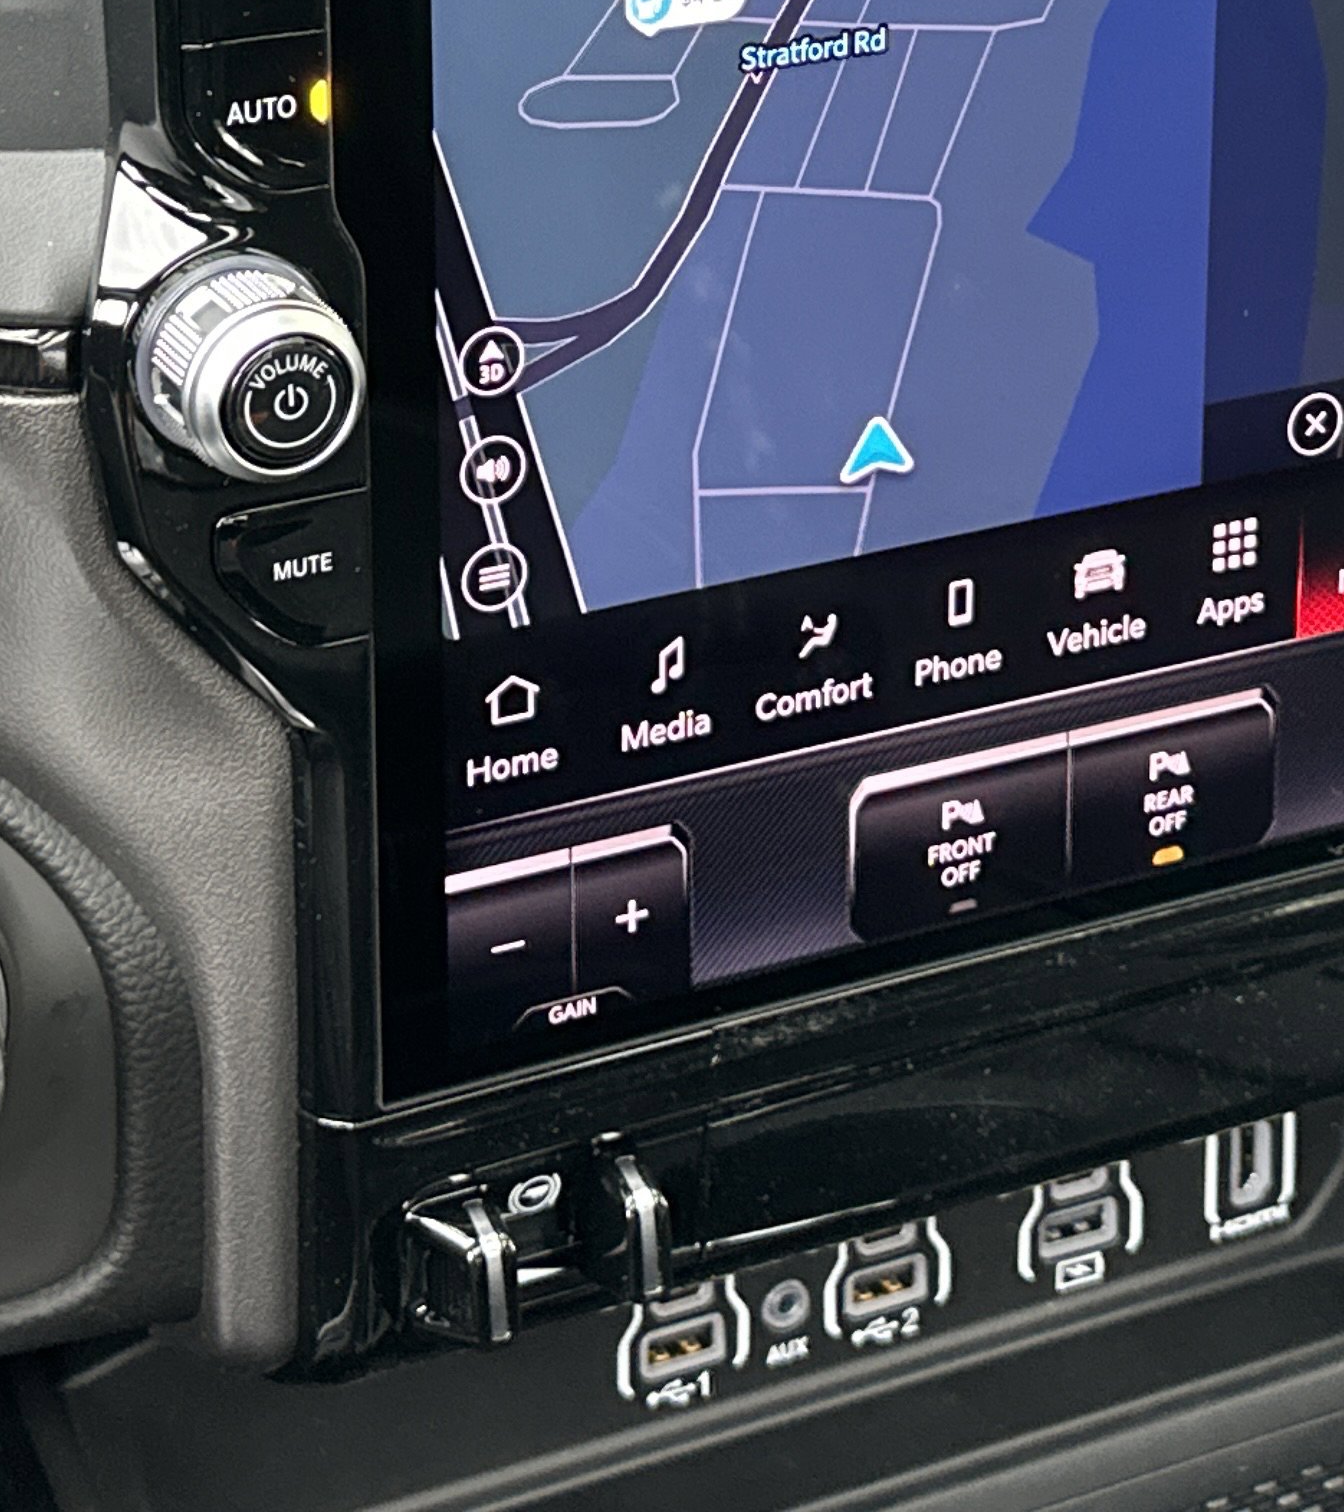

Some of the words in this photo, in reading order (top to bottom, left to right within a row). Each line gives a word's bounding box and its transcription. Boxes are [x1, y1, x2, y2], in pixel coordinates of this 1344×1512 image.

[741, 32, 848, 72] Stratford
[854, 27, 887, 52] Rd
[227, 95, 296, 126] AUTO
[248, 354, 330, 392] VOLUME
[478, 364, 505, 384] 3D
[273, 552, 333, 582] MUTE
[1197, 589, 1265, 626] Apps
[1047, 614, 1147, 658] Vehicle
[914, 648, 1003, 687] Phone
[756, 672, 873, 722] Comfort
[621, 710, 712, 752] Media
[467, 747, 559, 787] Home
[1143, 785, 1194, 813] REAR
[1148, 810, 1187, 837] OFF
[927, 831, 997, 867] FRONT
[940, 859, 982, 888] OFF
[548, 997, 596, 1026] GAIN
[901, 1307, 920, 1336] 2
[697, 1370, 710, 1398] 1
